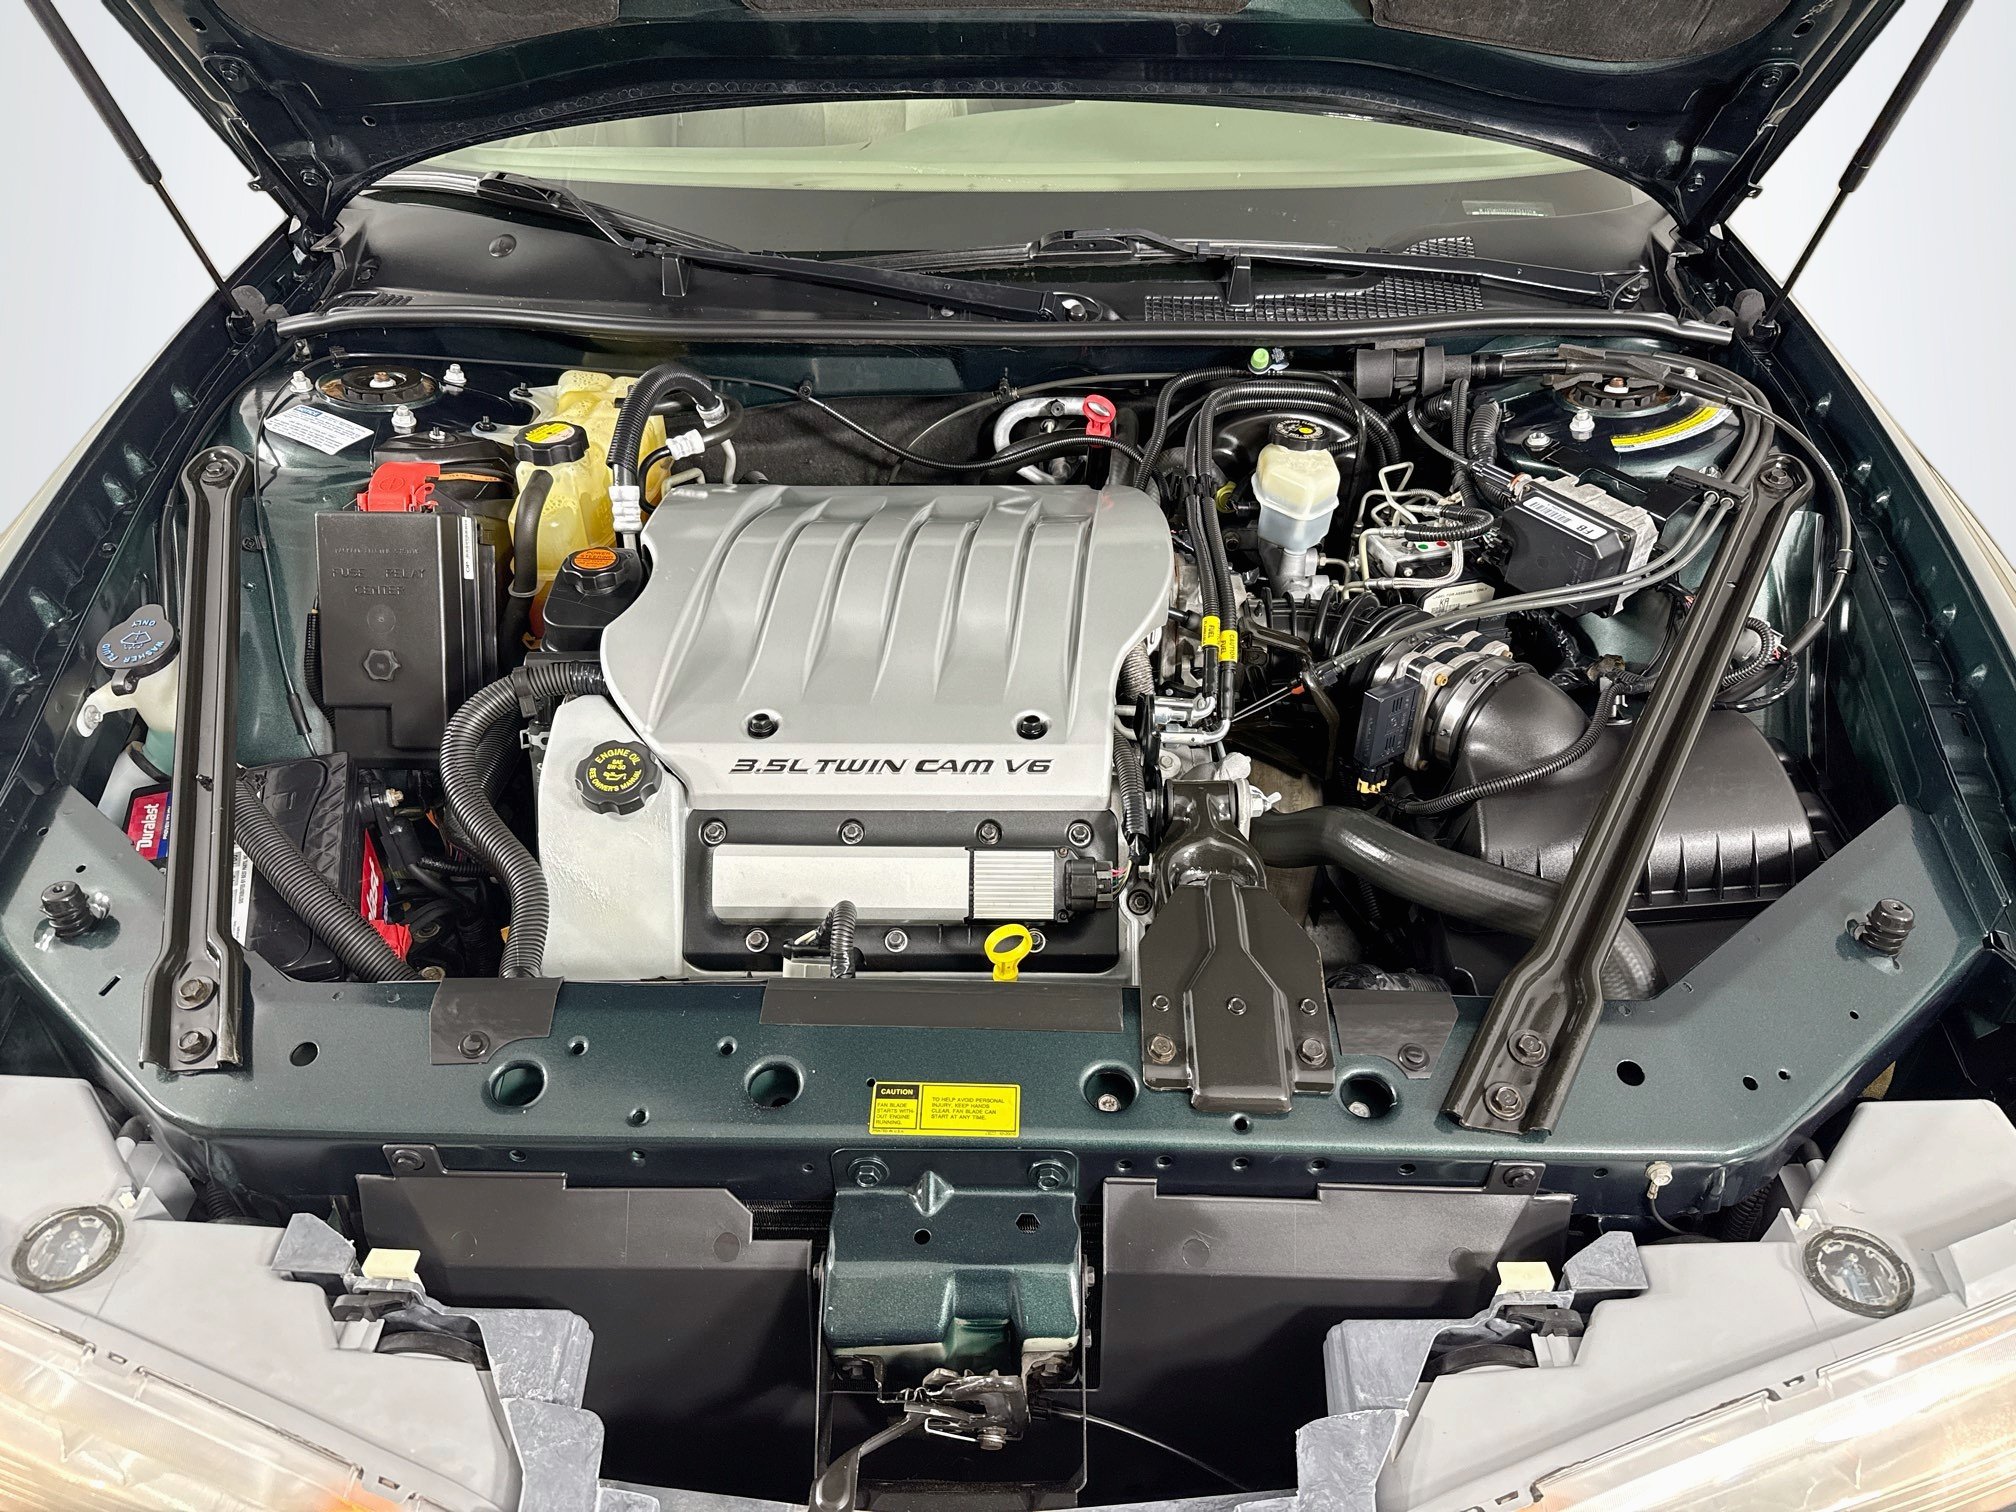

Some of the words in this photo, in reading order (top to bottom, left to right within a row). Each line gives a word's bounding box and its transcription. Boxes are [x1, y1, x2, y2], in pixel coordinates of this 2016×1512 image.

[1576, 525, 1595, 535] FB
[331, 568, 366, 579] FUSE
[384, 568, 426, 579] RELAY
[354, 585, 406, 596] CENTER
[131, 619, 156, 628] ONLY
[1207, 625, 1215, 639] FUEL
[102, 643, 119, 662] FLUID
[123, 640, 165, 663] WASHER
[594, 748, 631, 764] ENGINE
[628, 753, 641, 766] OIL
[589, 767, 597, 780] SEE
[728, 759, 808, 774] 3.5L
[813, 759, 907, 774] TWIN
[914, 759, 995, 774] CAM
[1005, 759, 1053, 774] V6
[591, 779, 620, 792] OWNER'S
[620, 769, 642, 790] MANUAL
[135, 803, 160, 852] Duralast
